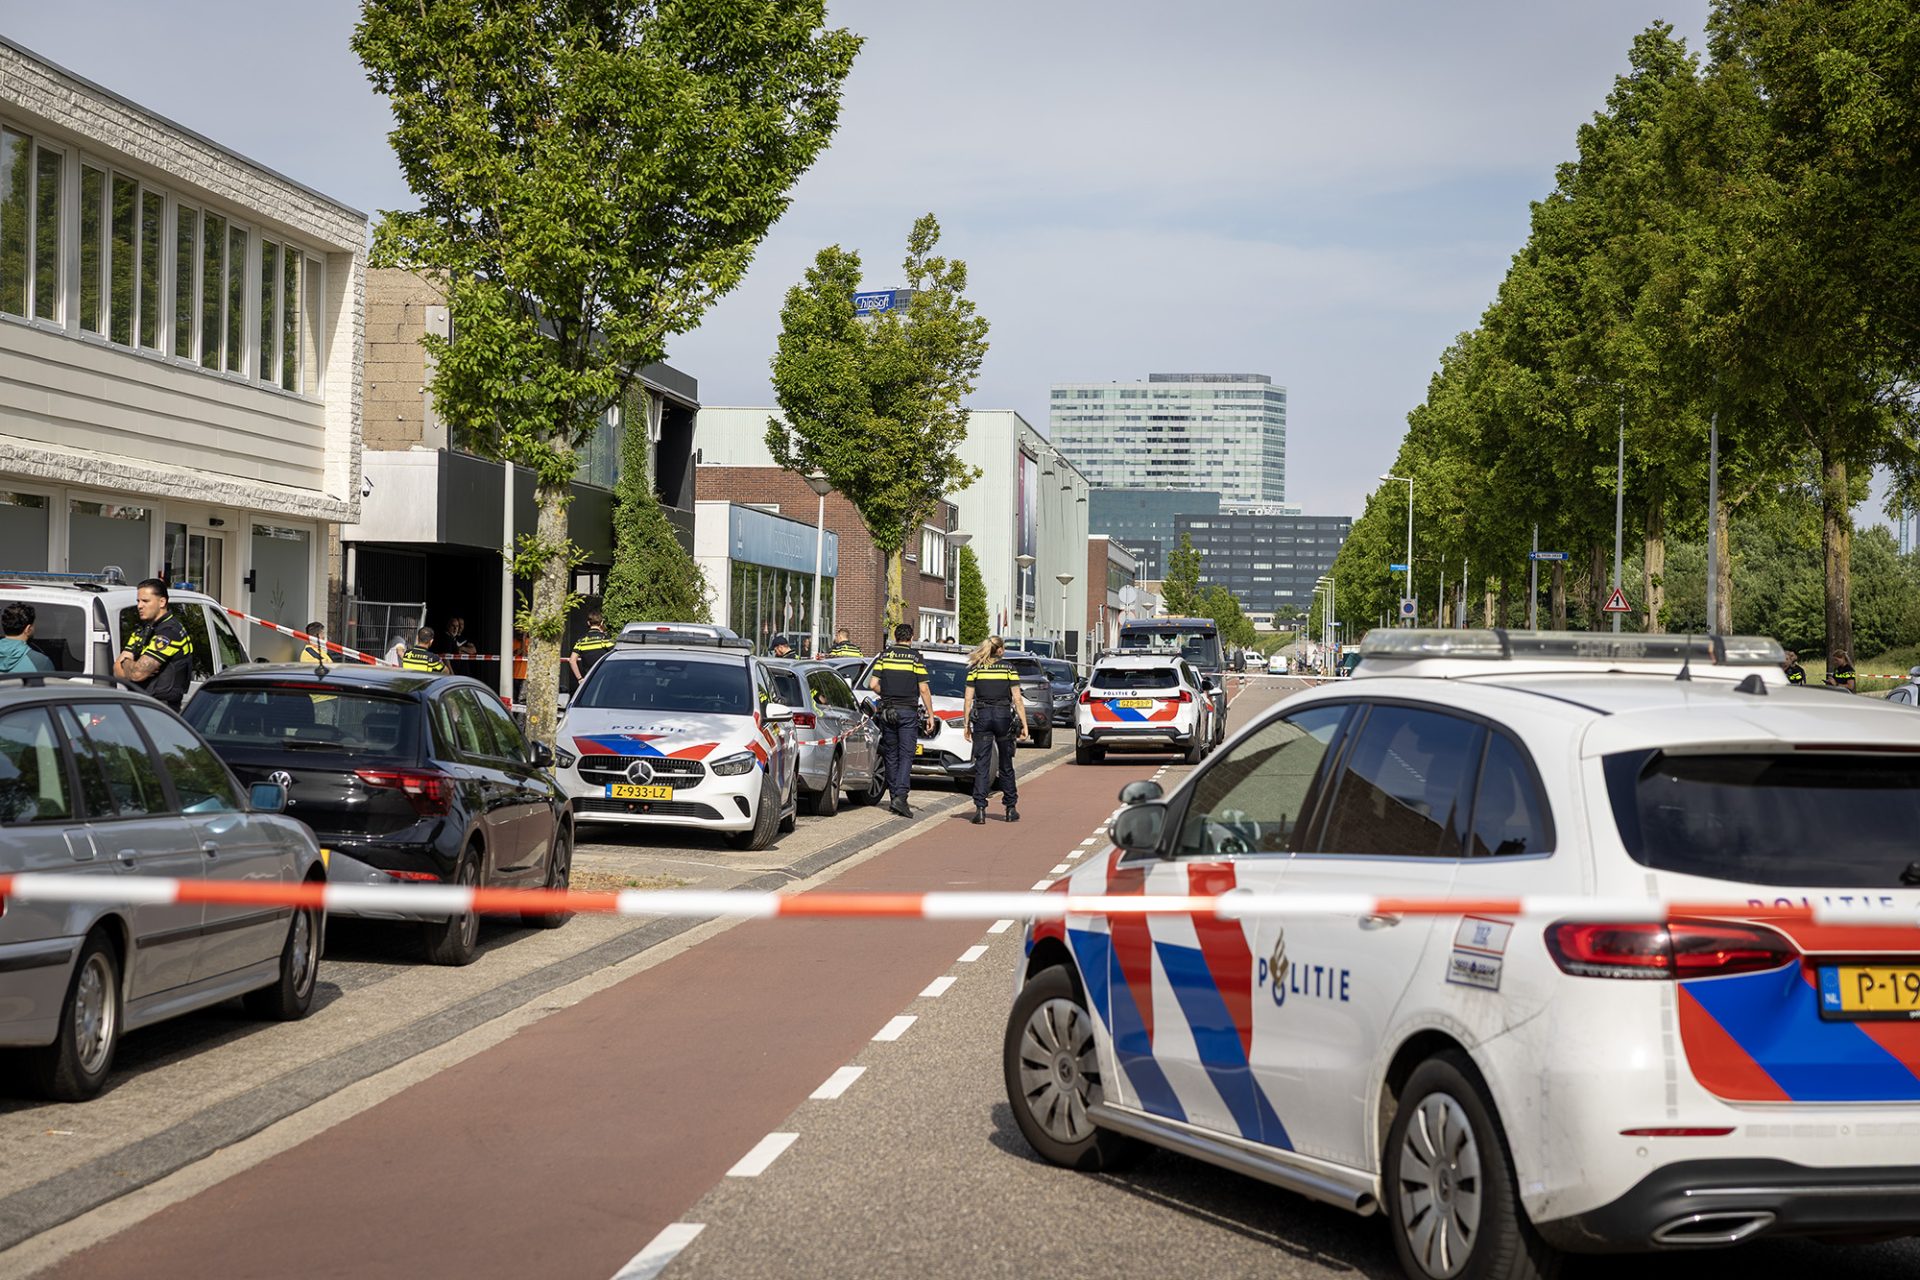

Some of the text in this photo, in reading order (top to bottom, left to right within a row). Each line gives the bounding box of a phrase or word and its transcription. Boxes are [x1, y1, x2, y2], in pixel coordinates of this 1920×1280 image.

[611, 725, 686, 733] POLITIE
[616, 785, 666, 799] Z-933-LZ
[1258, 957, 1350, 1008] POLITIE
